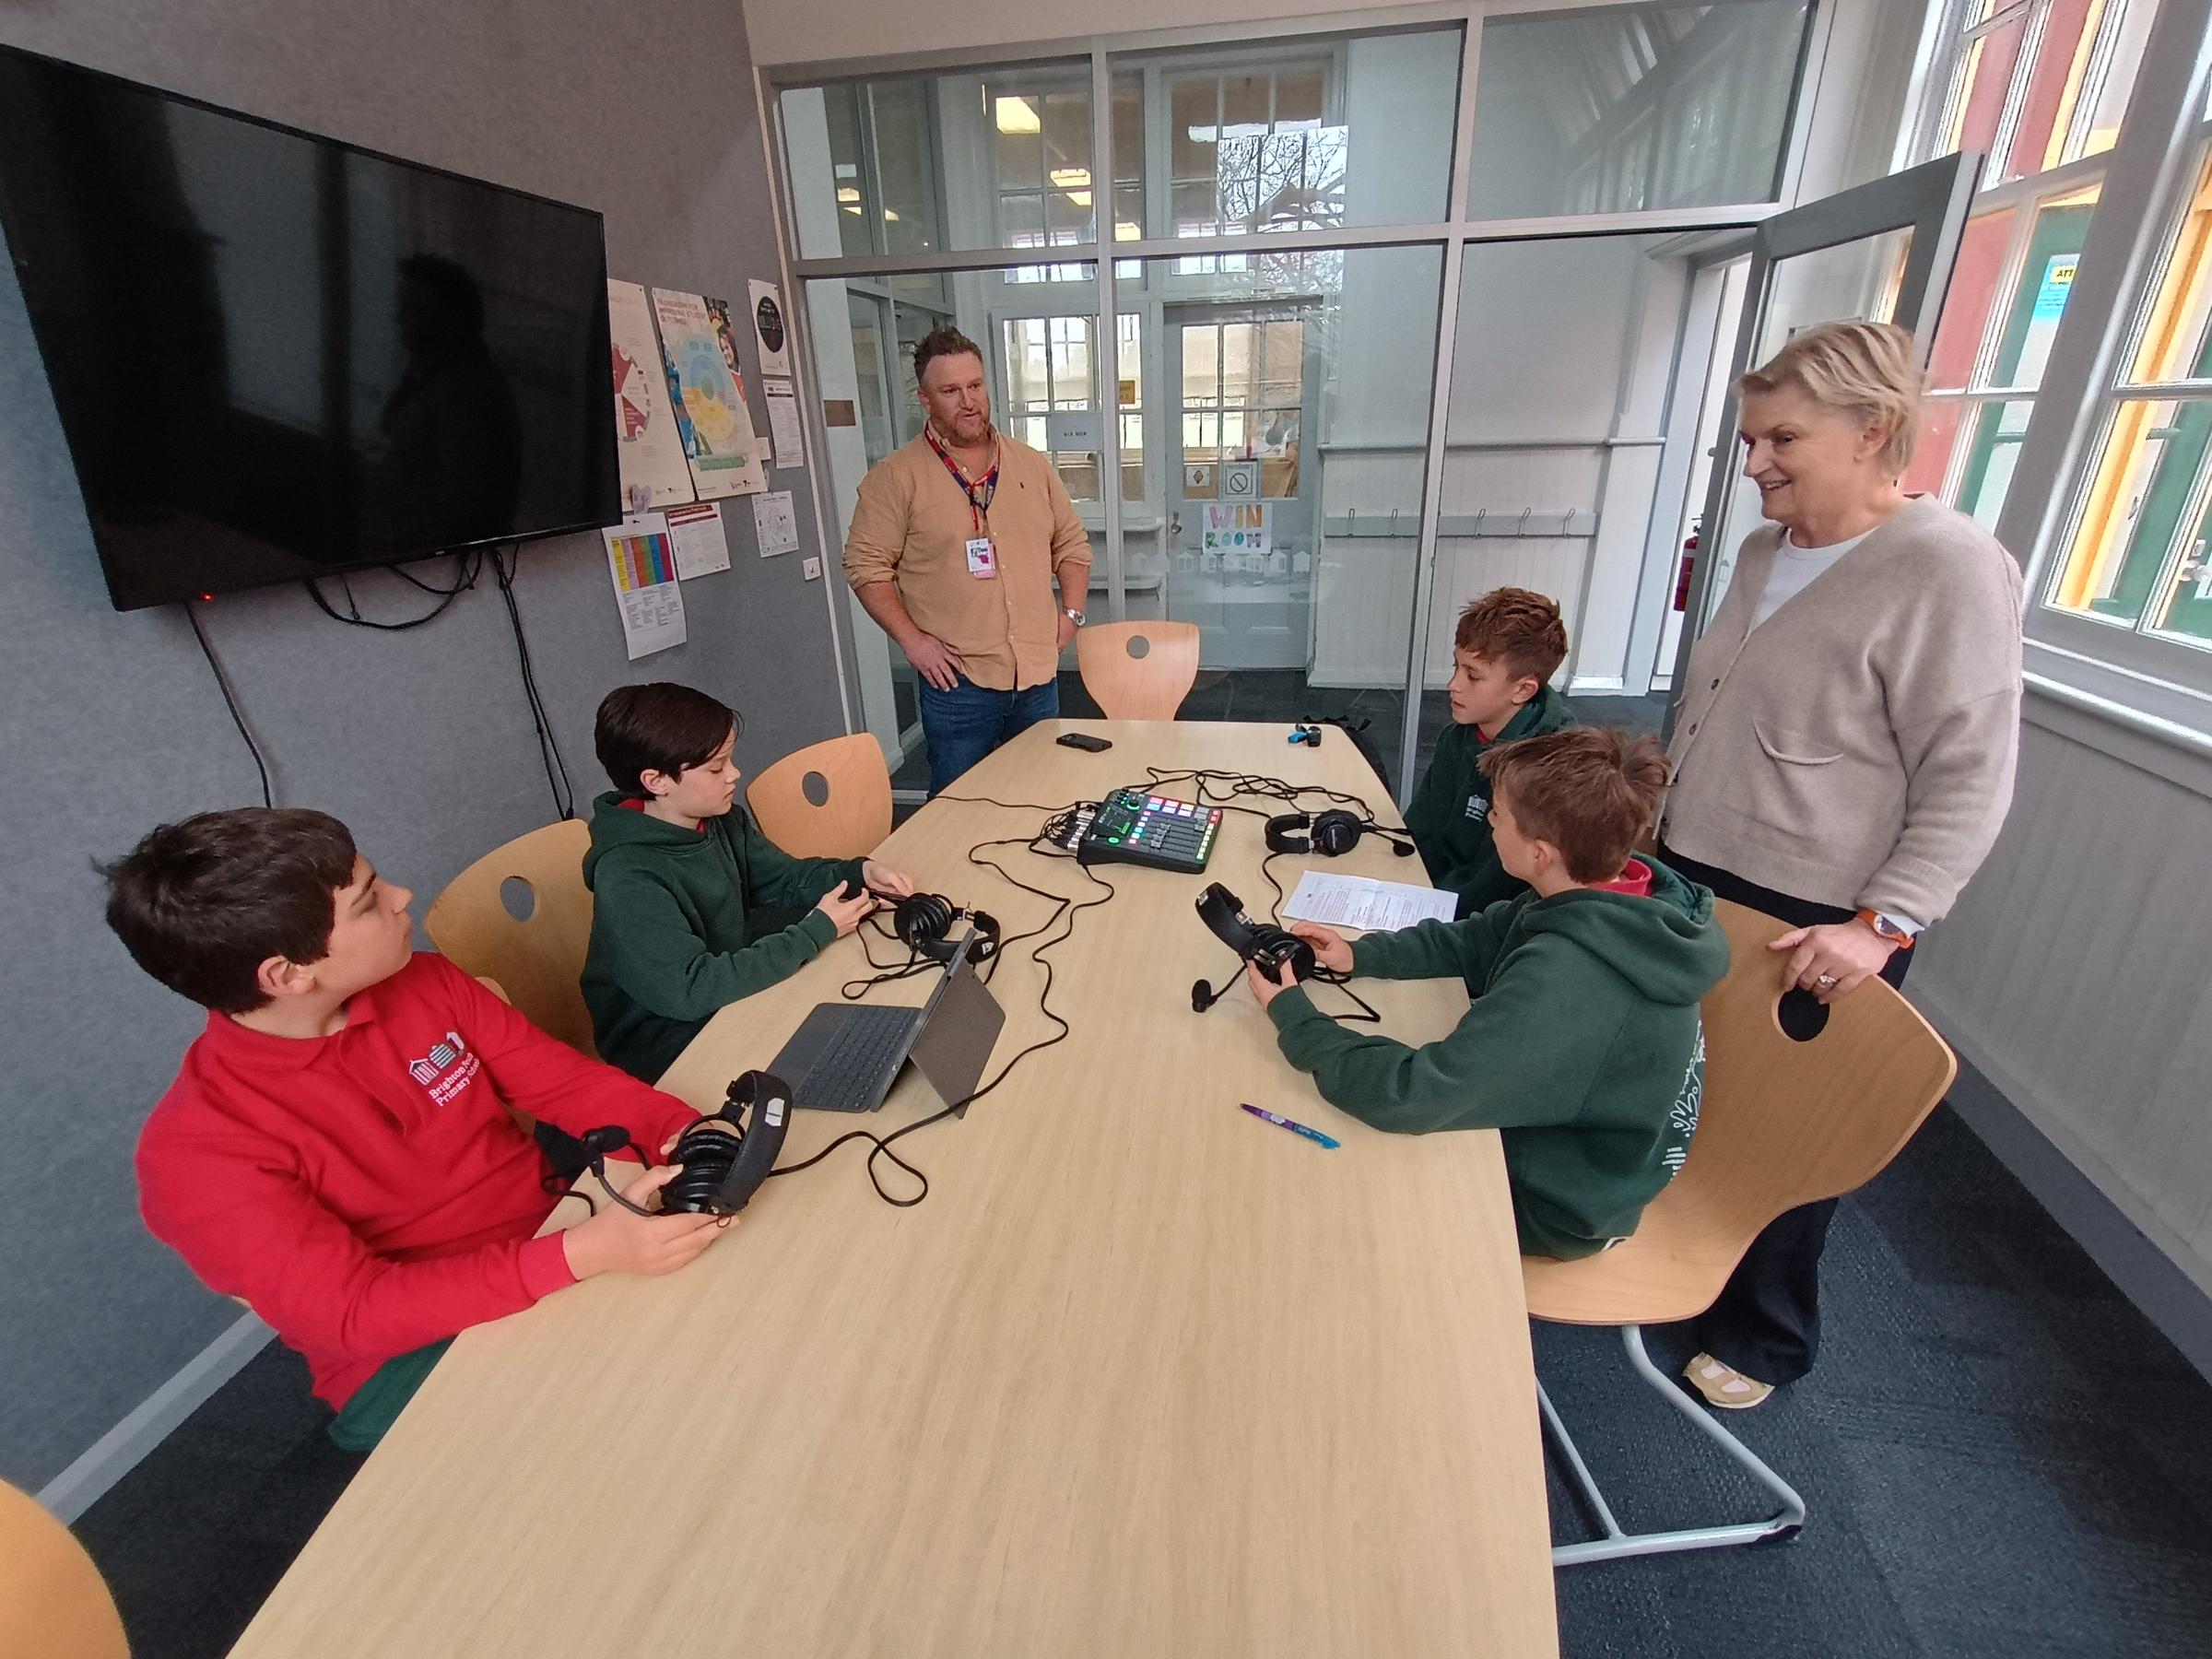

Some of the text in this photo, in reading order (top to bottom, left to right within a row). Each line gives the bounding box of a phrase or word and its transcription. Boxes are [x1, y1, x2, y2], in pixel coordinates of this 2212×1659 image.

[1209, 504, 1263, 529] WIN
[1205, 532, 1262, 548] ROOM
[429, 1066, 466, 1099] Brighton
[435, 1077, 470, 1106] Primary
